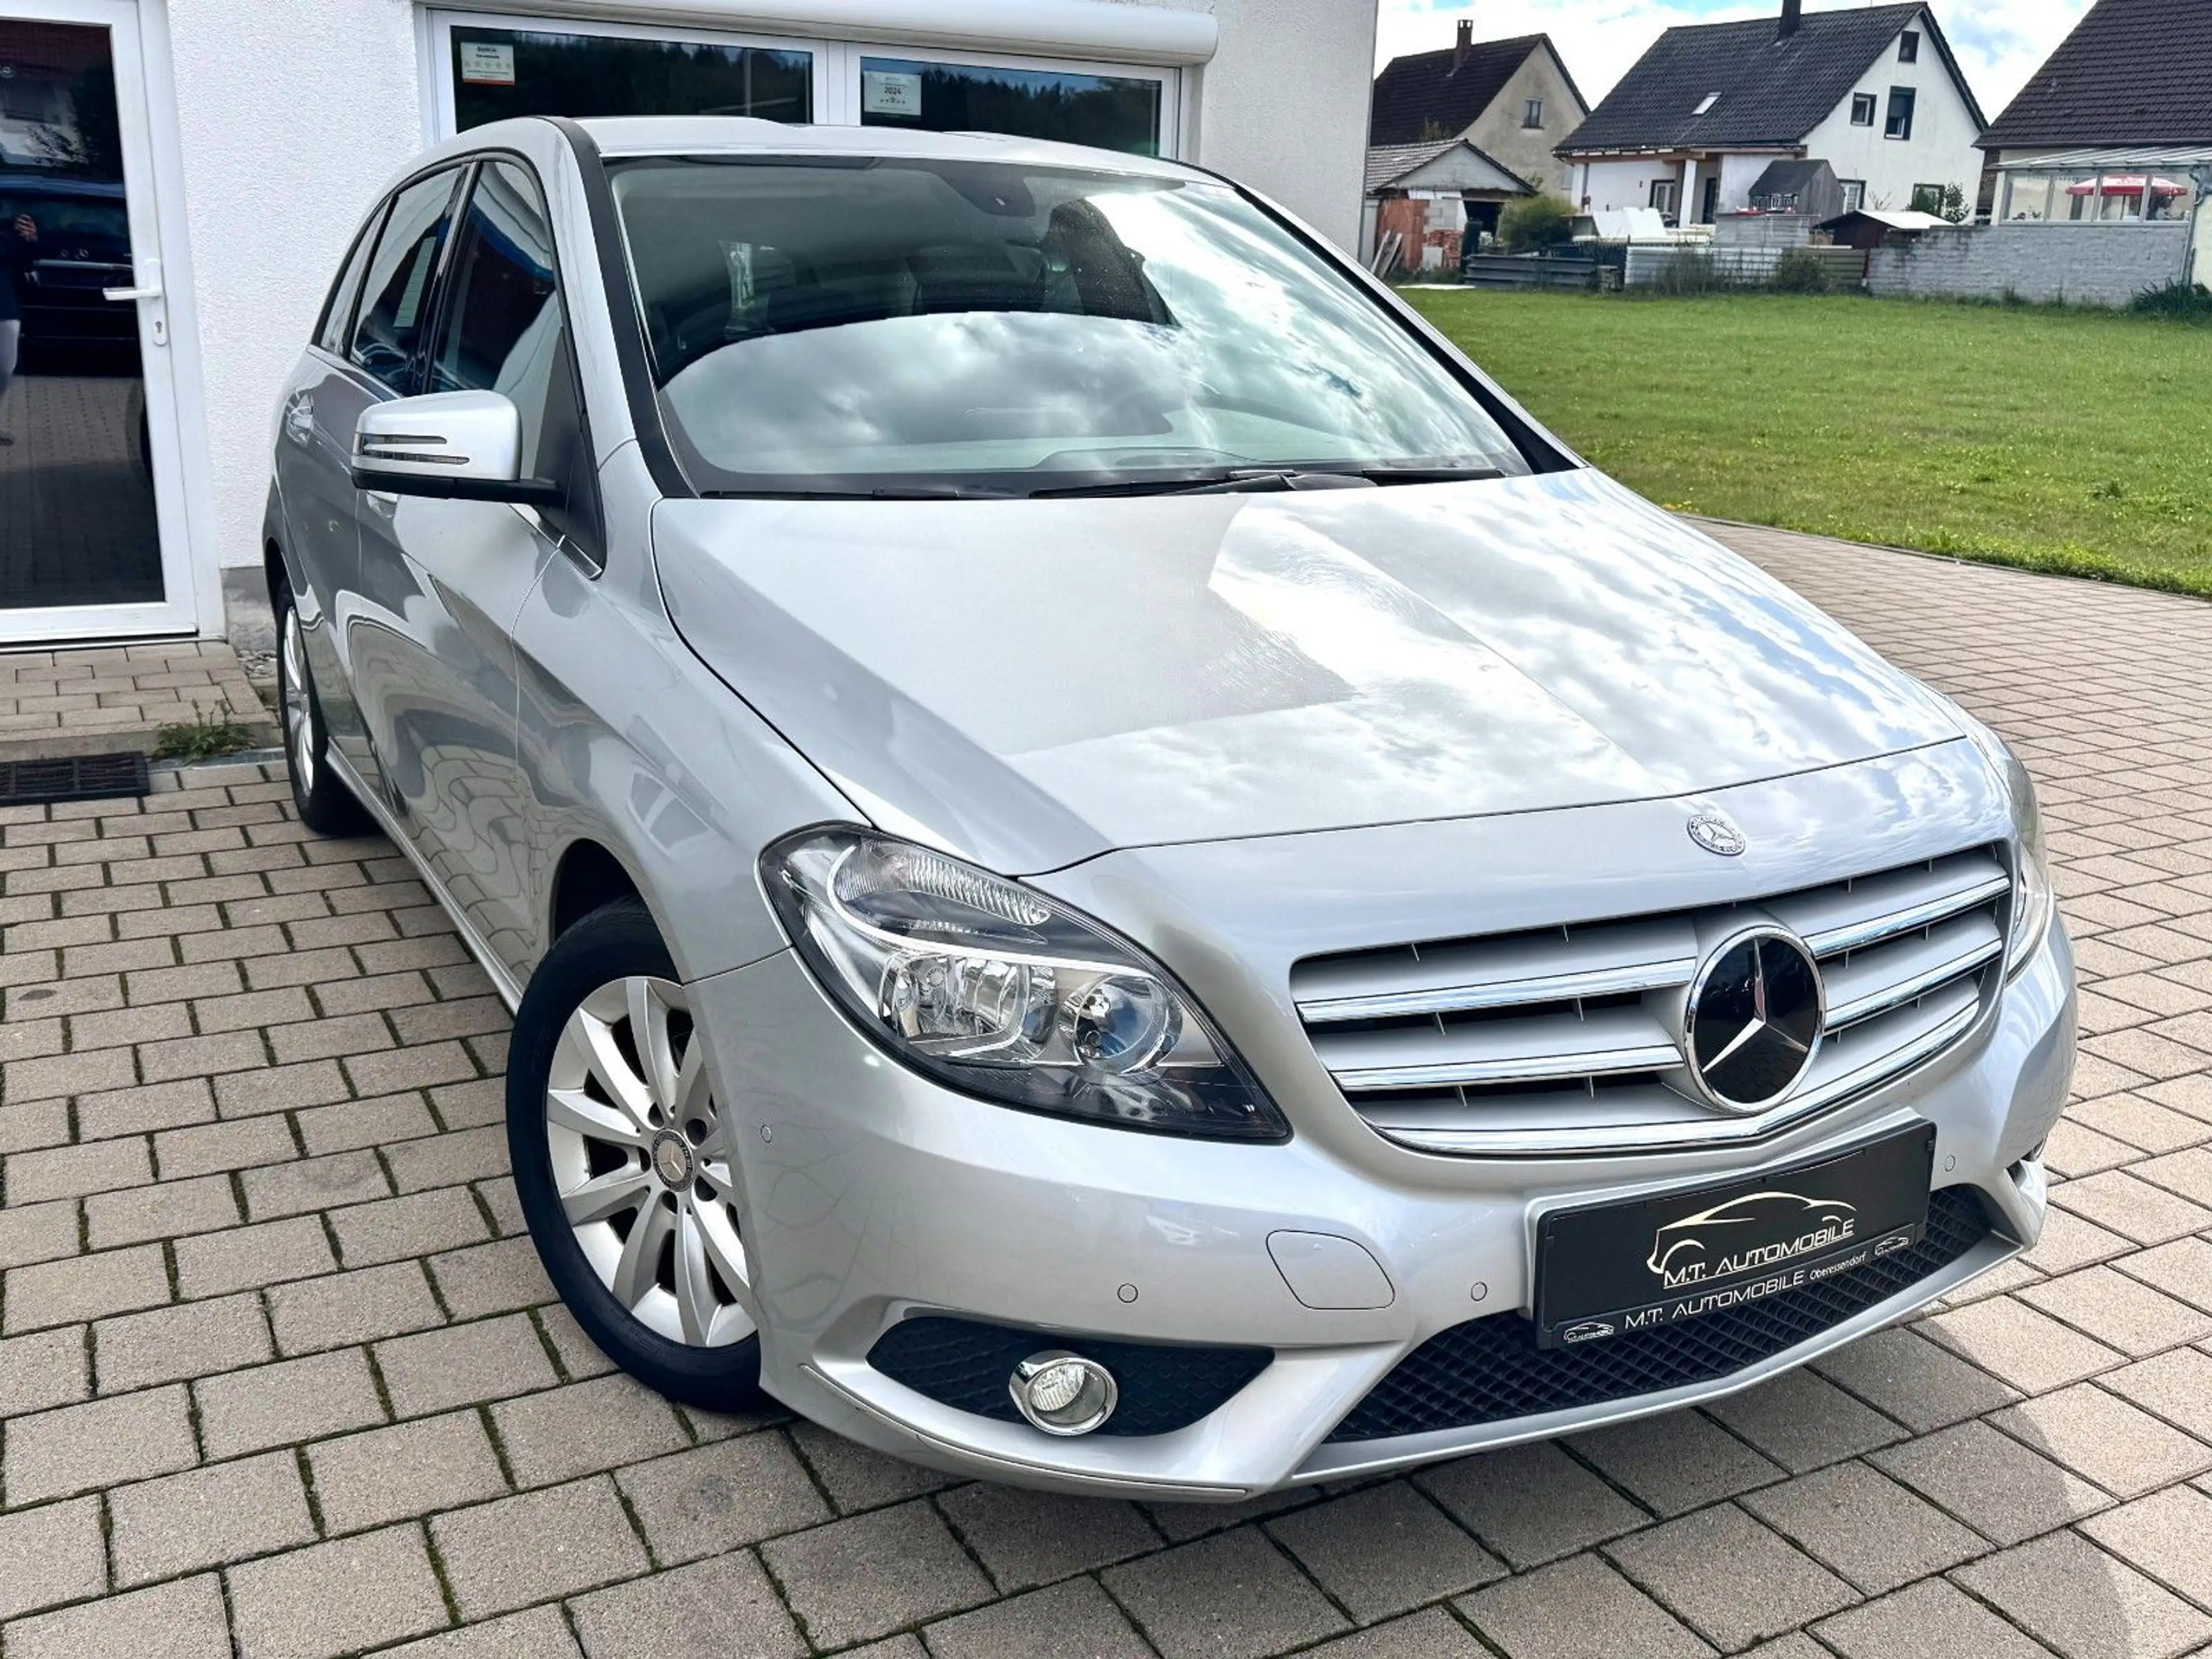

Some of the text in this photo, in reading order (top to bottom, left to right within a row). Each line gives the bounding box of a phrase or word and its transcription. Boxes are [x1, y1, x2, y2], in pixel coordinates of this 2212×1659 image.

[1664, 1218, 1855, 1287] M.T. AUTOMOBILE
[1625, 1308, 1663, 1330] M.T.
[1672, 1270, 1805, 1319] AUTOMOBILE
